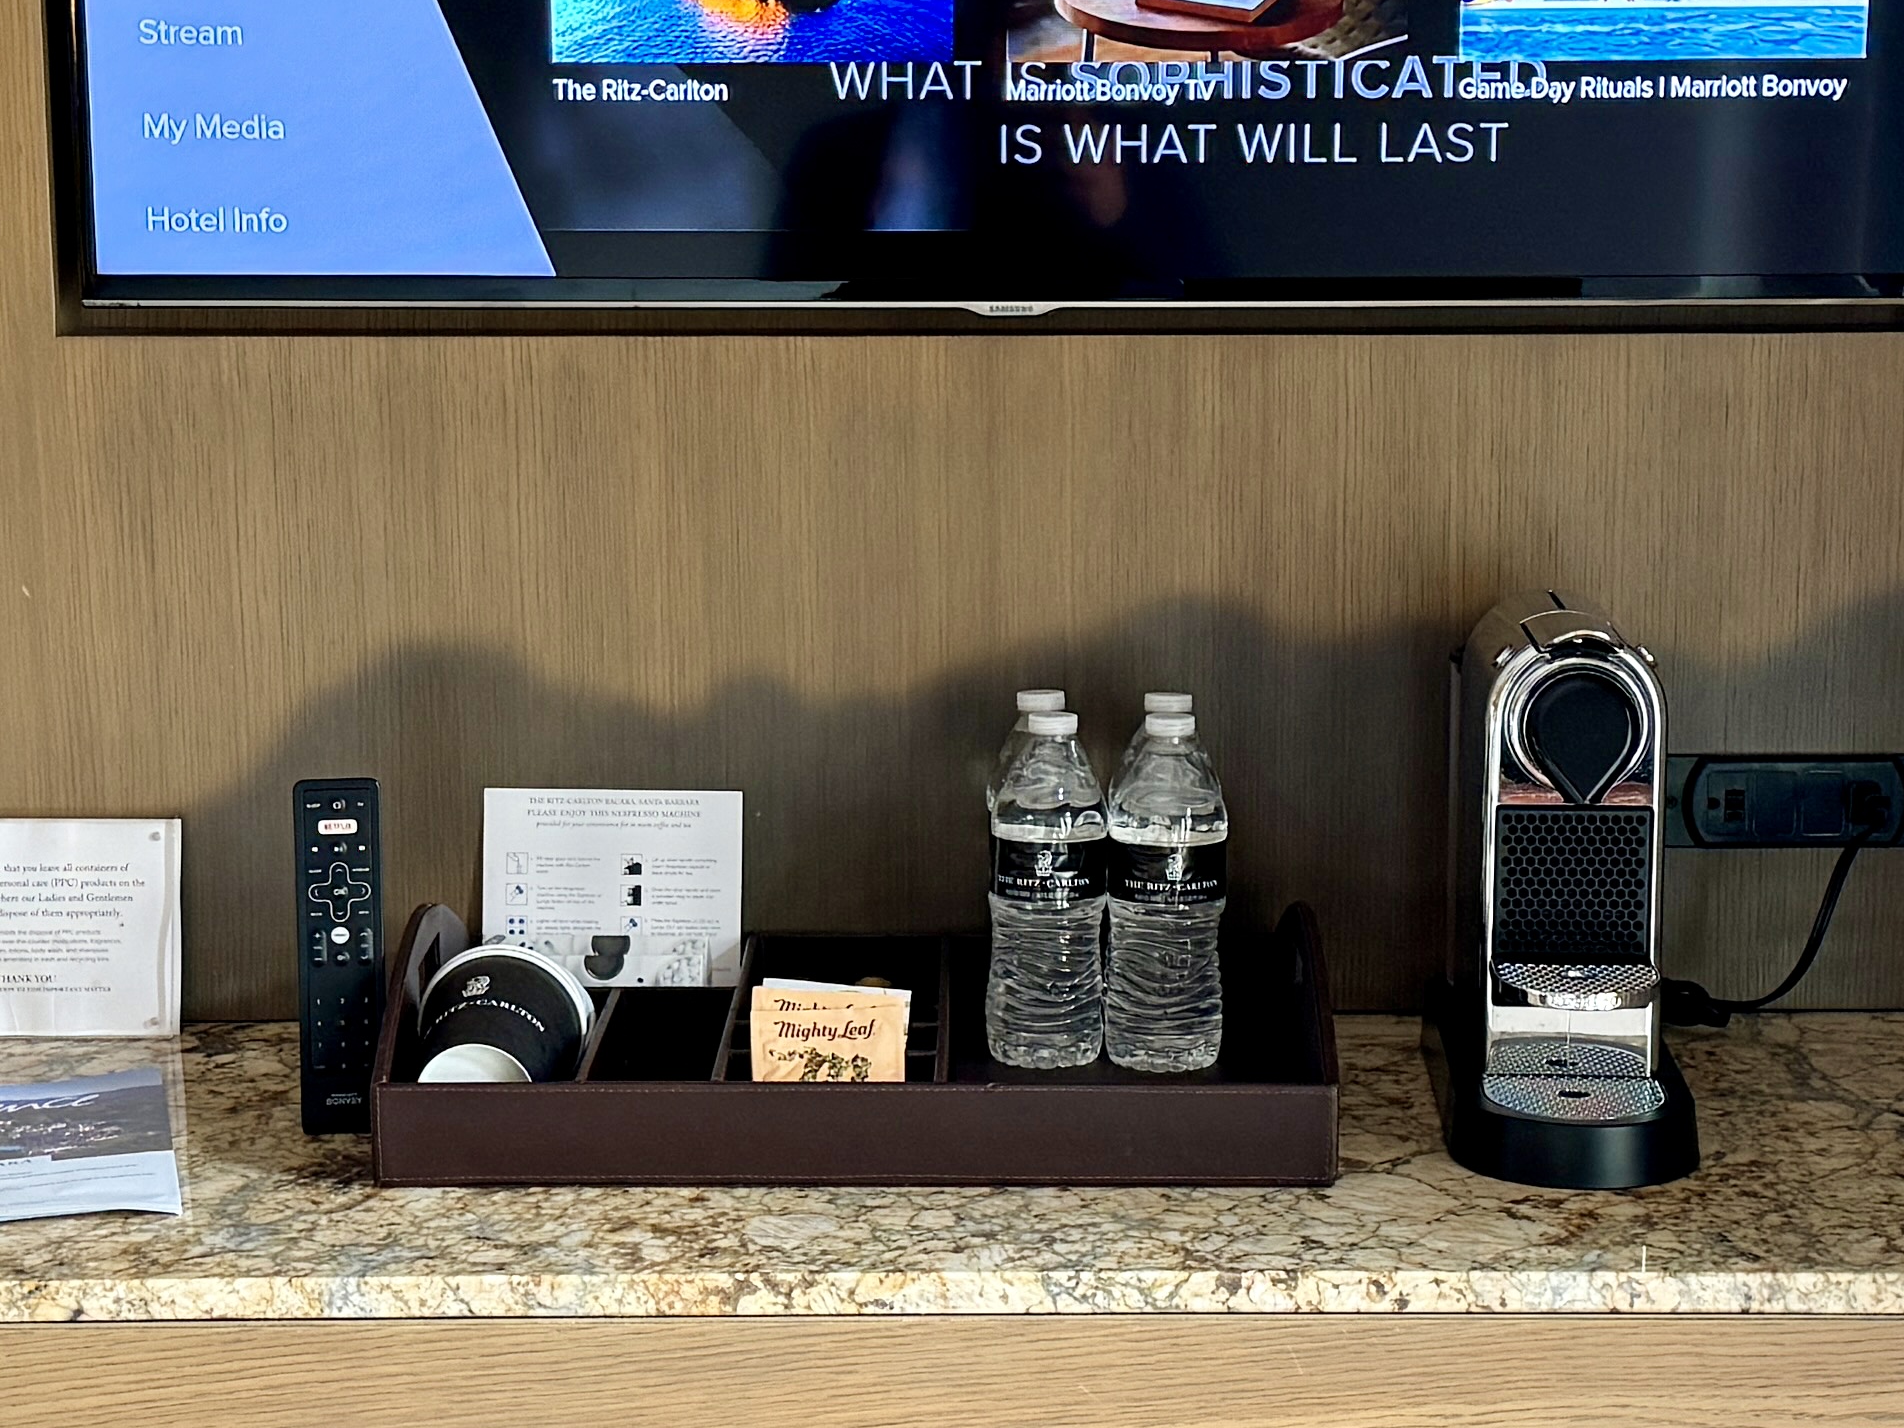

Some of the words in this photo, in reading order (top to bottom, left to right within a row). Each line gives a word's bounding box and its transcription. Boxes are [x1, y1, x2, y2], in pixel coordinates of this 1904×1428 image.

[137, 18, 244, 46] Stream
[552, 77, 596, 102] The
[601, 77, 730, 103] Ritz-Carlton
[830, 60, 983, 101] WHAT
[1006, 78, 1091, 102] Marriott
[1096, 79, 1181, 106] Bonvoy
[1186, 79, 1217, 102] TV
[1458, 77, 1526, 100] Game
[1530, 77, 1576, 103] Day
[1580, 75, 1653, 99] Rituals
[1670, 74, 1758, 98] Marriott
[1763, 73, 1848, 101] Bonvoy
[142, 112, 188, 145] My
[195, 113, 286, 140] Media
[999, 123, 1042, 164] IS
[1063, 123, 1218, 164] WHAT
[1236, 122, 1358, 164] WILL
[1380, 121, 1510, 164] LAST
[146, 206, 225, 234] Hotel
[233, 207, 289, 234] Info
[773, 1020, 838, 1042] Mighty
[838, 1018, 876, 1040] Leaf
